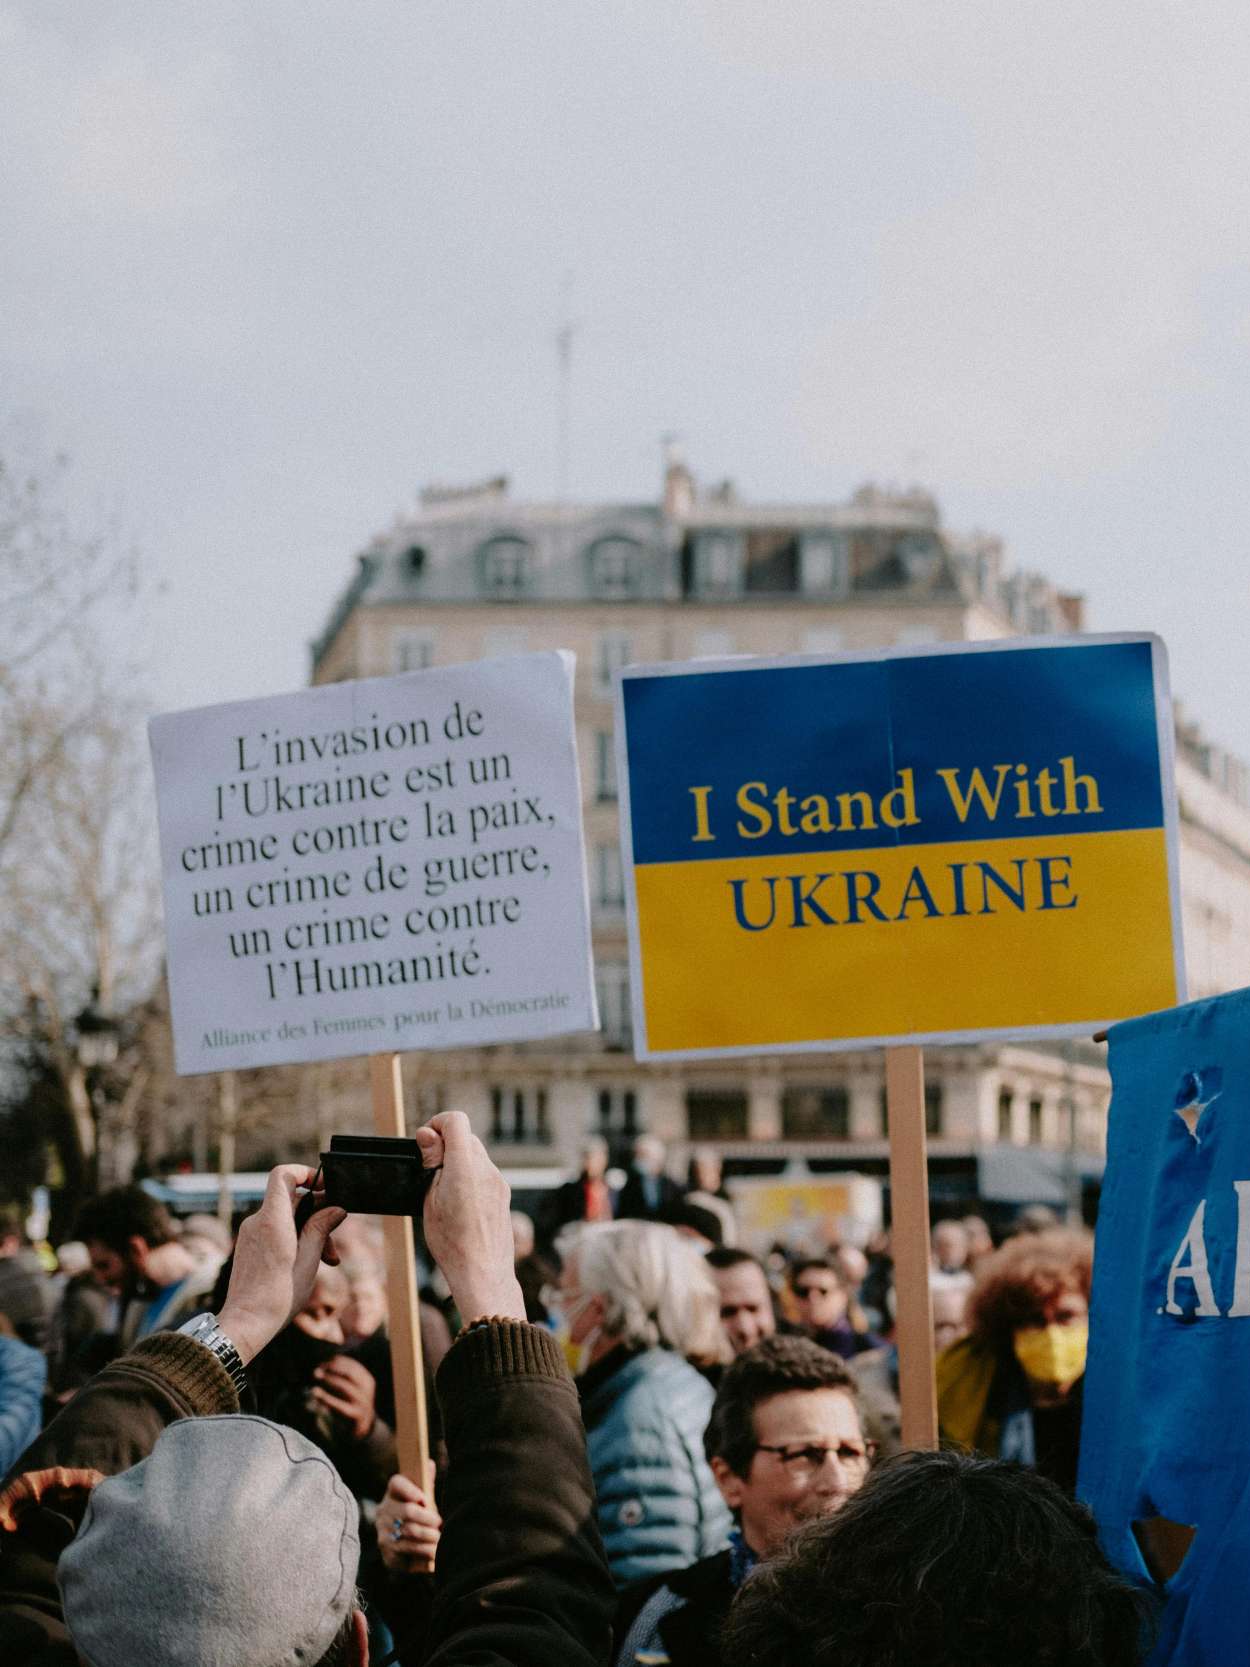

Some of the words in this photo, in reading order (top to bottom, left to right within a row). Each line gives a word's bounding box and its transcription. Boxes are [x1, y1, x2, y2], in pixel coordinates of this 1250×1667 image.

[235, 713, 430, 772] L'invasion
[444, 702, 485, 740] de
[215, 767, 391, 820] l'Ukraine
[405, 758, 456, 793] est
[469, 752, 512, 784] un
[689, 786, 715, 841] I
[735, 768, 921, 839] Stand
[937, 756, 1104, 823] With
[181, 831, 279, 873] crime
[292, 814, 408, 857] contre
[424, 801, 456, 839] la
[470, 788, 556, 843] paix,
[193, 886, 233, 917] un
[246, 868, 352, 910] crime
[364, 856, 408, 895] de
[424, 844, 551, 896] guerre,
[727, 856, 1079, 932] UKRAINE
[229, 928, 271, 959] un
[284, 909, 391, 951] crime
[405, 894, 521, 936] contre
[201, 1029, 271, 1050] Alliance
[277, 1023, 307, 1042] des
[313, 1014, 386, 1035] Femmes
[394, 1009, 440, 1032] pour
[449, 1003, 463, 1022] la
